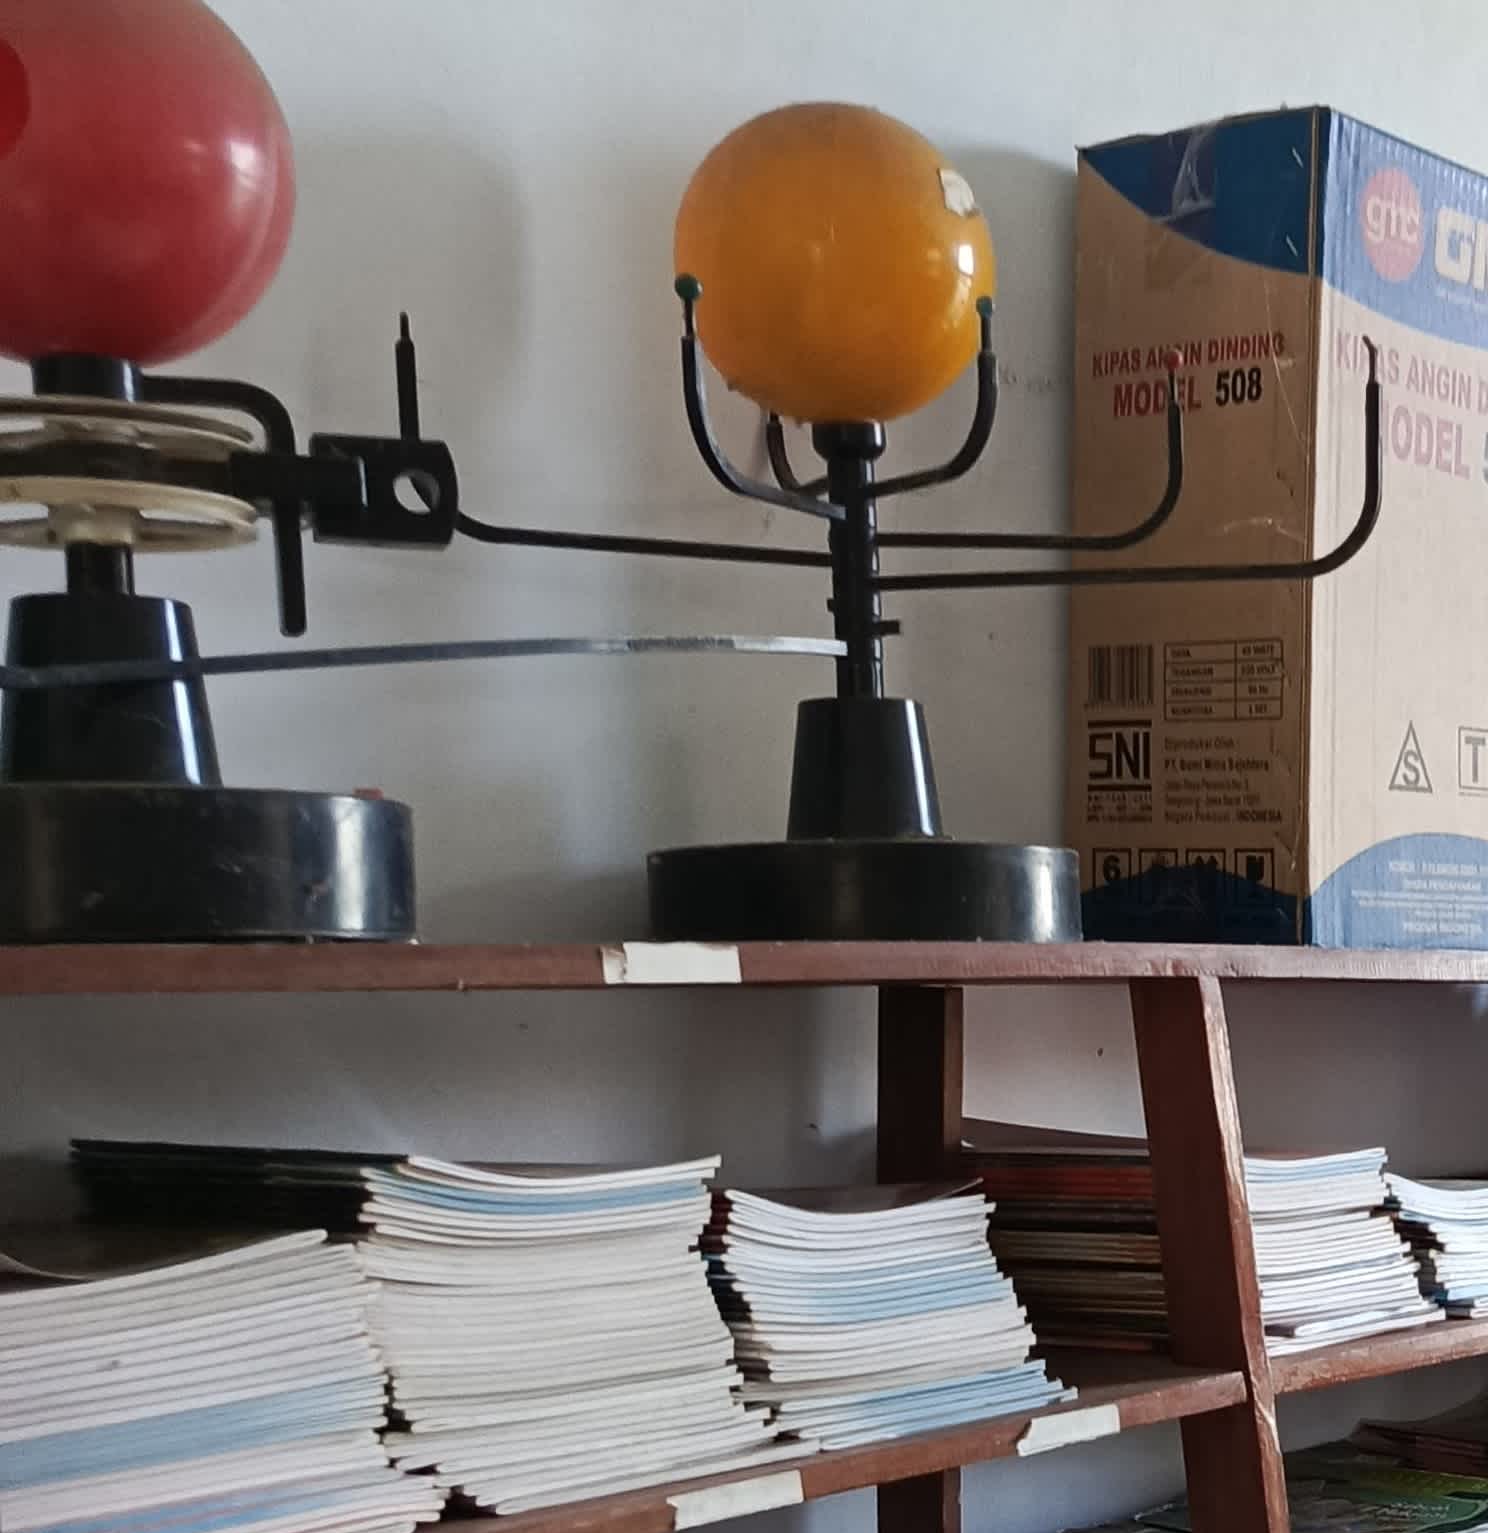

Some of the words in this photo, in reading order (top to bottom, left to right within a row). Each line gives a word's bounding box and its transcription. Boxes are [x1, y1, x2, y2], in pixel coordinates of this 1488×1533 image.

[1092, 347, 1141, 378] KIPAS
[1146, 340, 1201, 370] ANIN
[1208, 331, 1285, 363] DINDING
[1113, 376, 1202, 418] MODEL
[1215, 365, 1263, 408] 508
[1406, 354, 1472, 412] ANGIN
[1088, 730, 1151, 780] SNI
[1402, 749, 1421, 786] S
[1463, 735, 1487, 784] T
